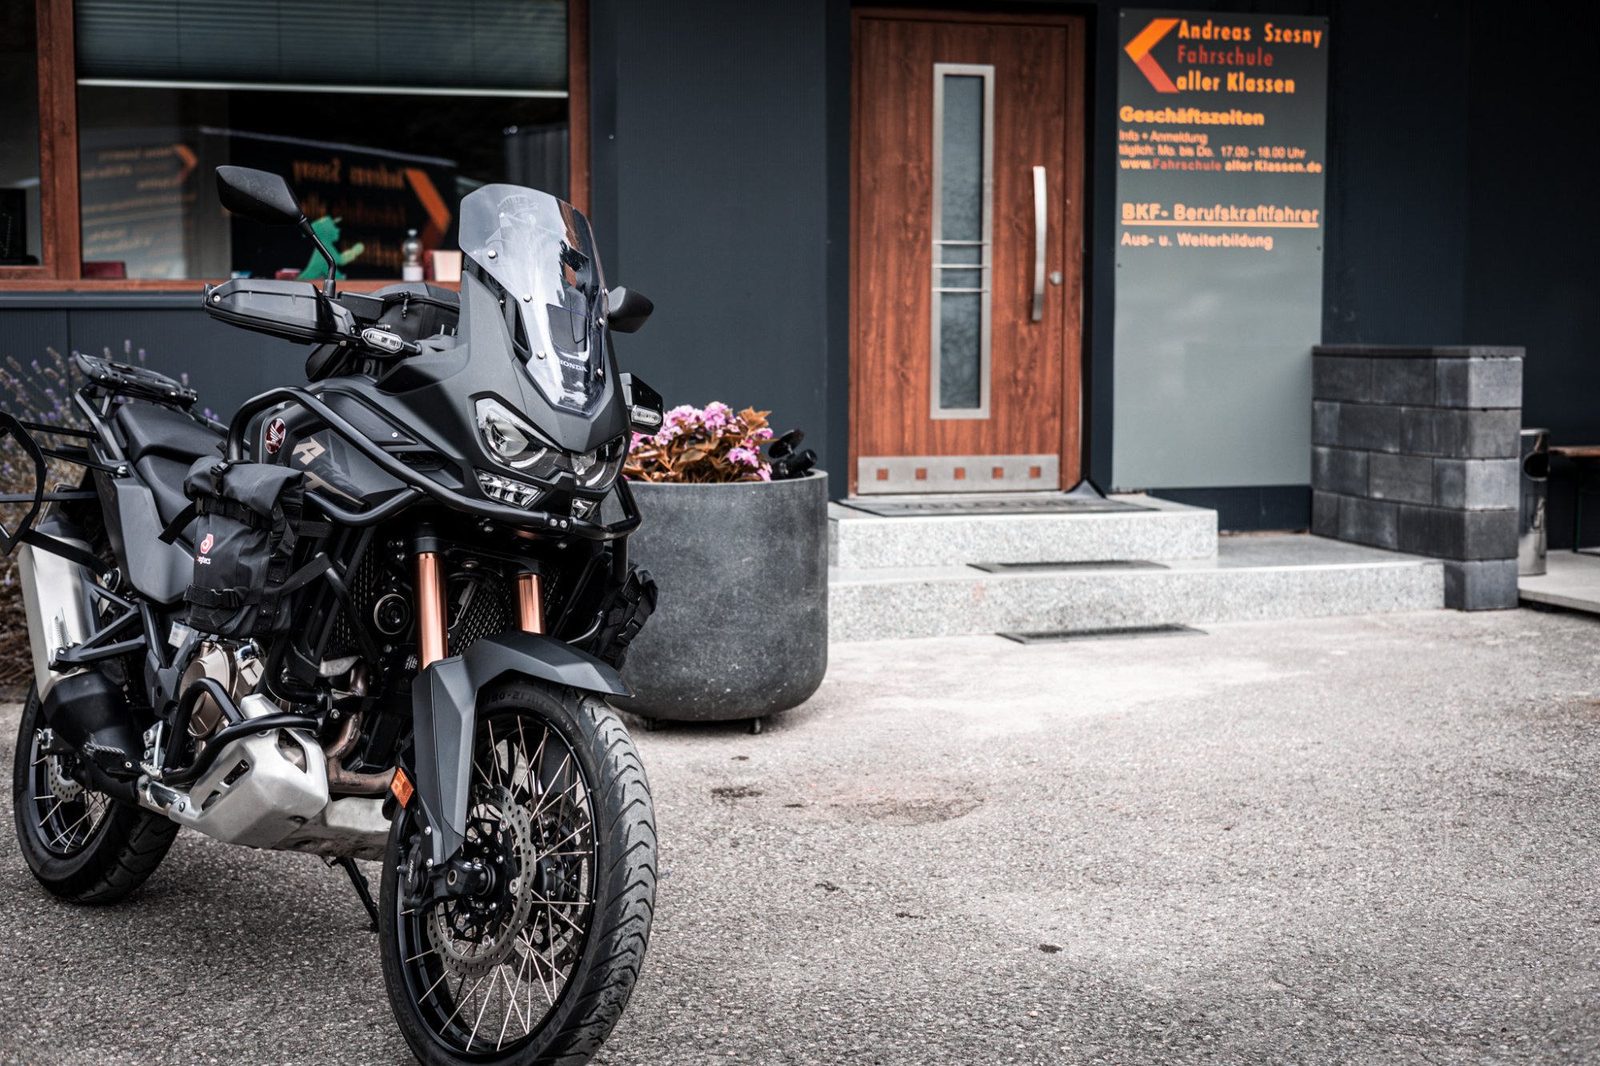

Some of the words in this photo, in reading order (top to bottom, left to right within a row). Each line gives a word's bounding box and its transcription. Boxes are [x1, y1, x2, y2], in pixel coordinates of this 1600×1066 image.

[1178, 19, 1251, 41] Andreas
[1264, 22, 1323, 48] Szesny
[1177, 45, 1274, 66] Fahrschule
[1176, 70, 1220, 91] aller
[1227, 72, 1295, 93] Klassen
[1119, 106, 1265, 126] Geschäftszeiten
[1119, 130, 1140, 141] Info
[1150, 130, 1208, 146] Anmeldung
[1287, 147, 1306, 159] Uhr
[1122, 203, 1169, 221] BKF-
[1174, 204, 1319, 223] Berufskraftfahrer
[1121, 232, 1154, 246] Aus-
[1159, 236, 1172, 247] u.
[1177, 232, 1274, 251] Weiterbildung
